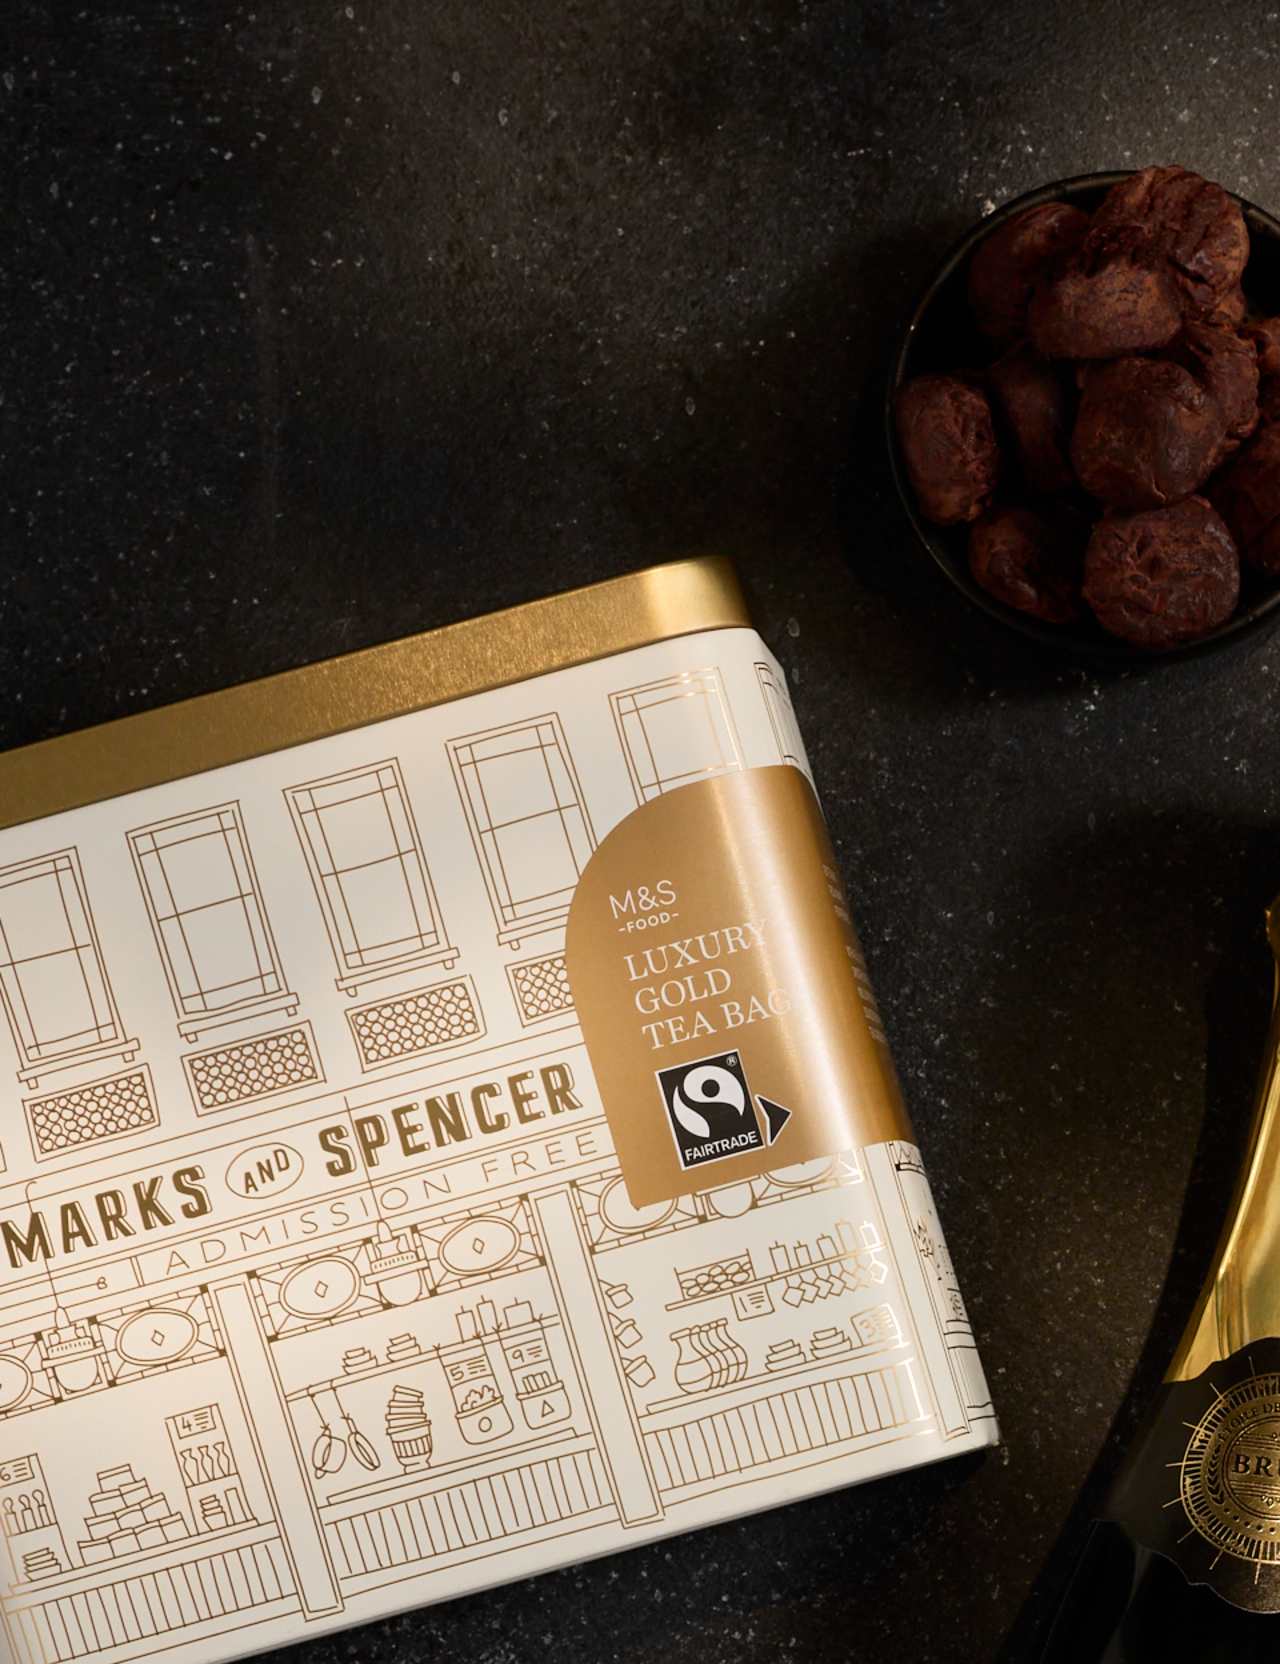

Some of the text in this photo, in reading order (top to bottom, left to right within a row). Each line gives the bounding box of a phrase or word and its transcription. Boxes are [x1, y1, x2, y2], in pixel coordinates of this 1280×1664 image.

[609, 879, 678, 919] M&S
[623, 918, 768, 982] LUXURY
[634, 967, 732, 1015] GOLD
[641, 1010, 718, 1051] TEA
[0, 1062, 584, 1269] MARKS AND SPENCER
[684, 1130, 759, 1161] FAIRTRADE
[166, 1131, 598, 1276] ADMISSION FREE
[1262, 1401, 1280, 1415] DE
